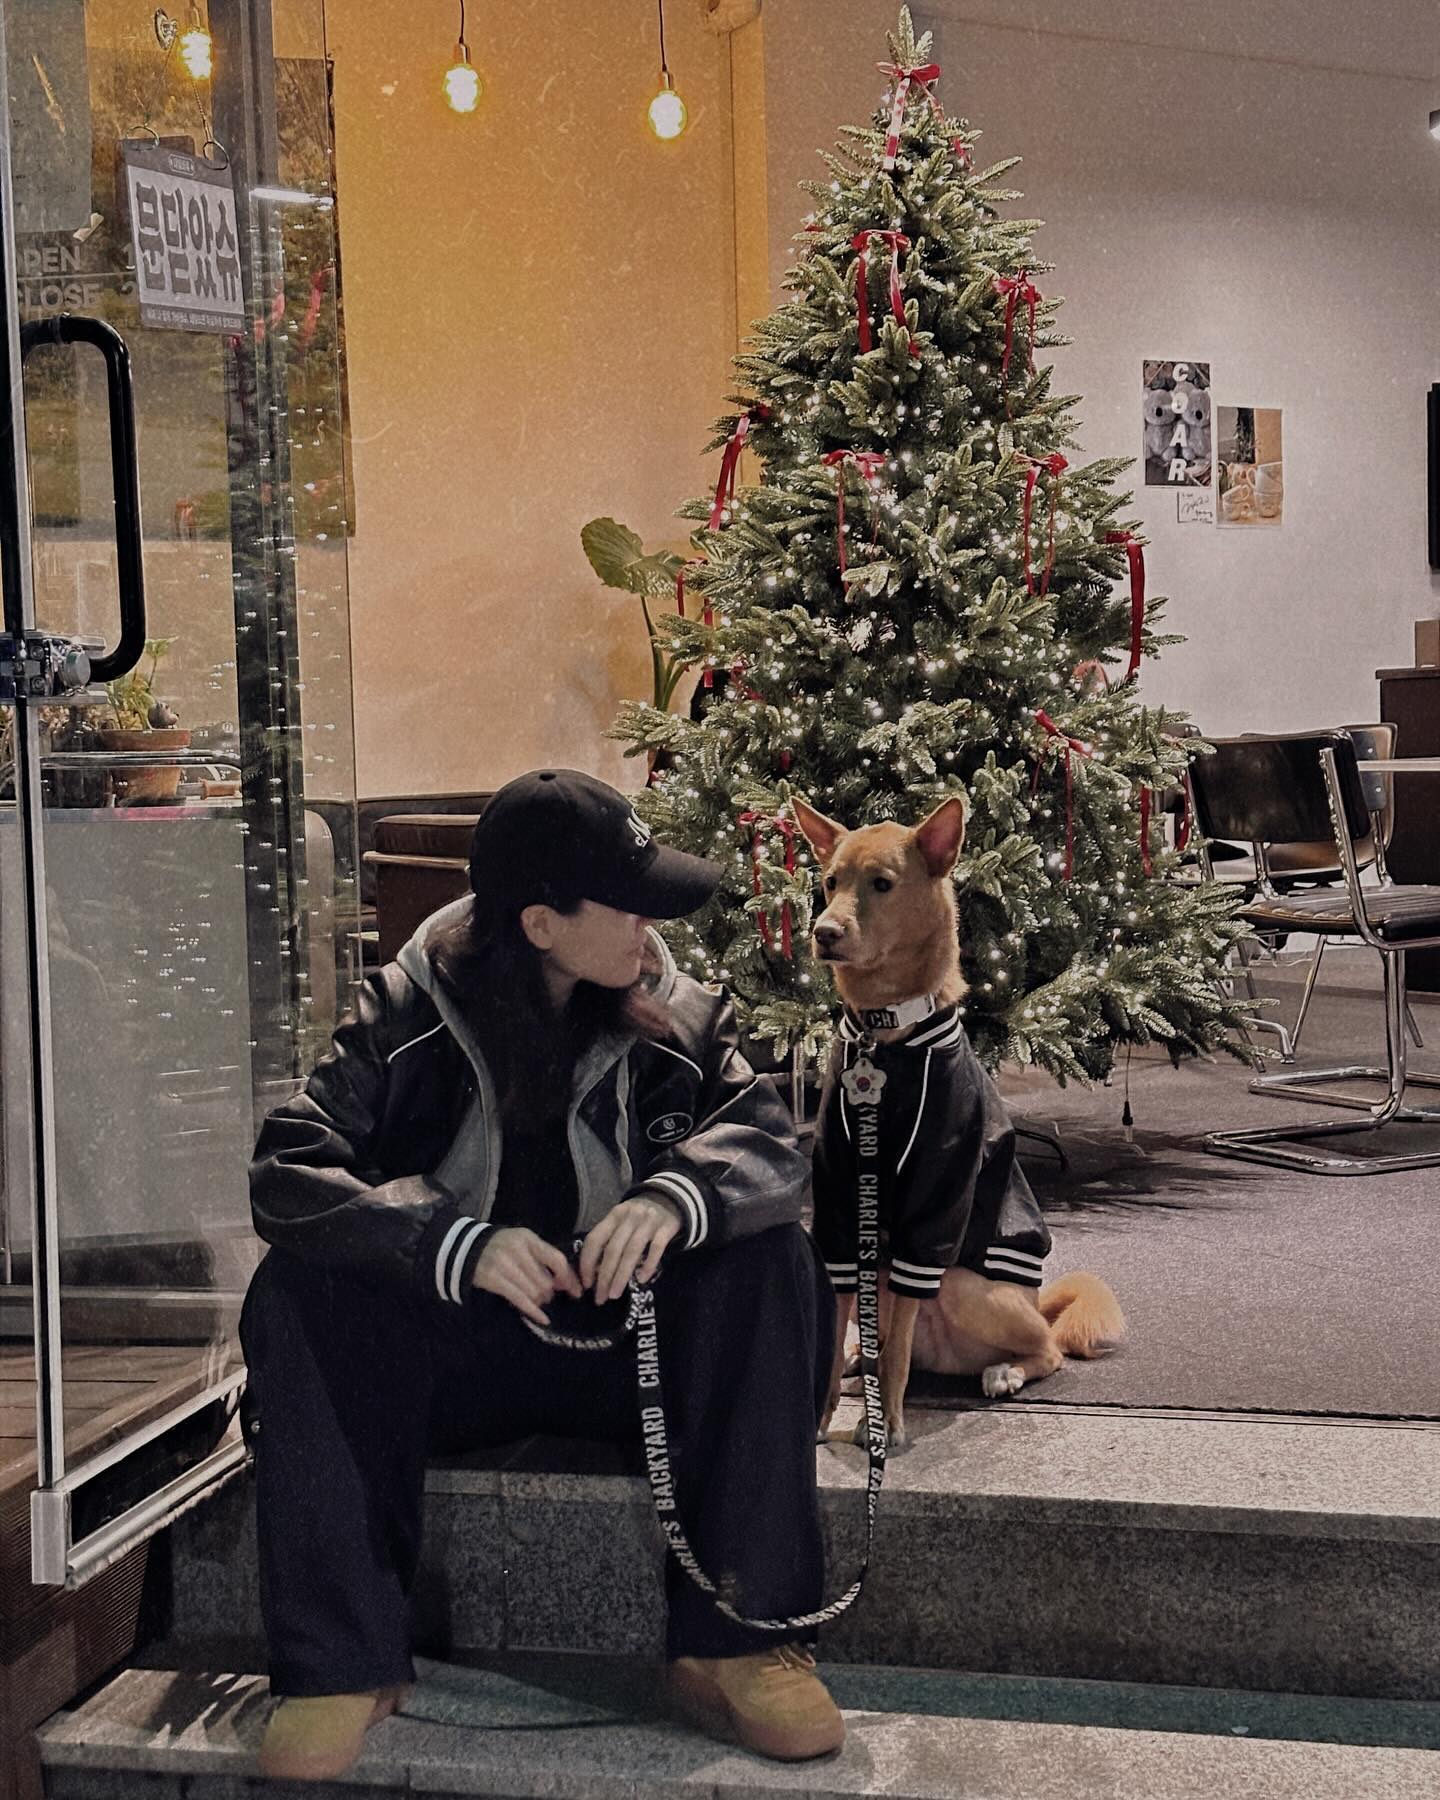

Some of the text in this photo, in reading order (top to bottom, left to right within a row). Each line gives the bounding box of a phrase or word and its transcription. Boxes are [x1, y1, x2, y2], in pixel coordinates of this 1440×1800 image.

[17, 245, 81, 275] PEN
[18, 283, 100, 310] LOSE
[858, 1174, 878, 1260] CHARLIE'S
[637, 1289, 659, 1388] CHARLIE'S
[859, 1270, 880, 1360] BACKYARD
[641, 1406, 676, 1512] BACKYARD
[863, 1373, 886, 1459] CHARLIE'S
